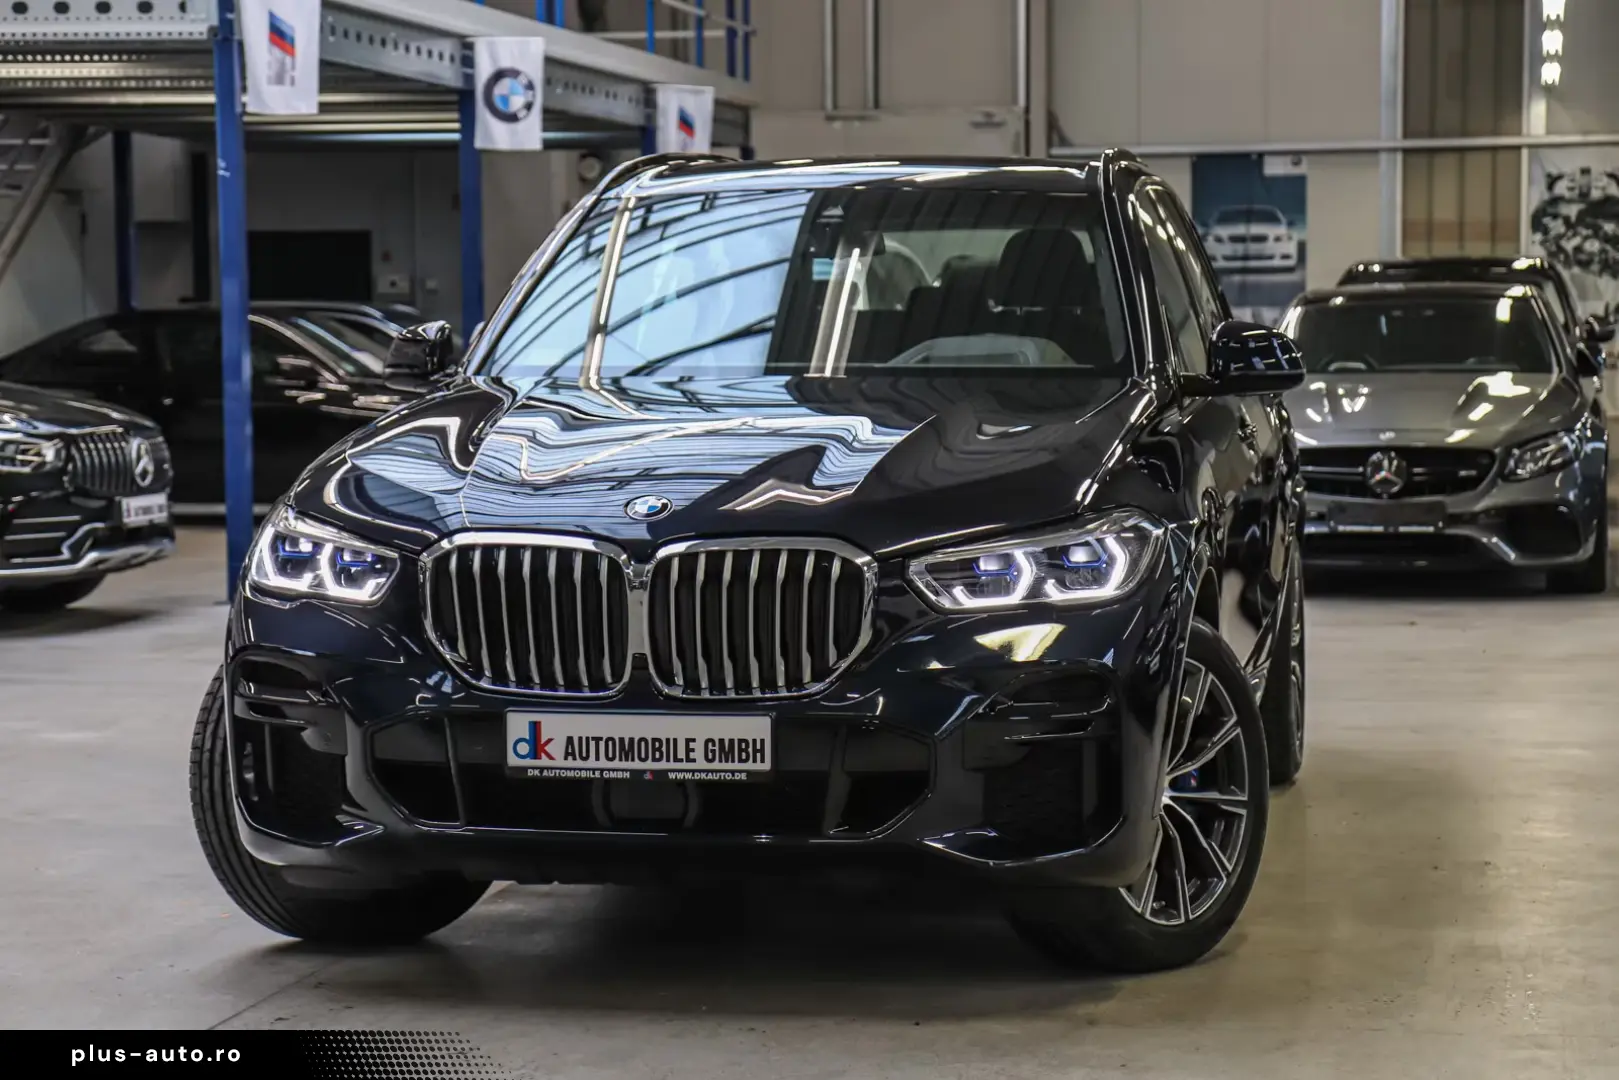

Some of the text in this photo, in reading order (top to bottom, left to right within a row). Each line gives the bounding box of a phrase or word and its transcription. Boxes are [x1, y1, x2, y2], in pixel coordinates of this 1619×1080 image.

[513, 720, 765, 764] dk AUTOMOBILE GMBH
[527, 769, 630, 779] DK AUTOMOBILE GMBH
[668, 772, 747, 780] WWW.DKAUTO.DE
